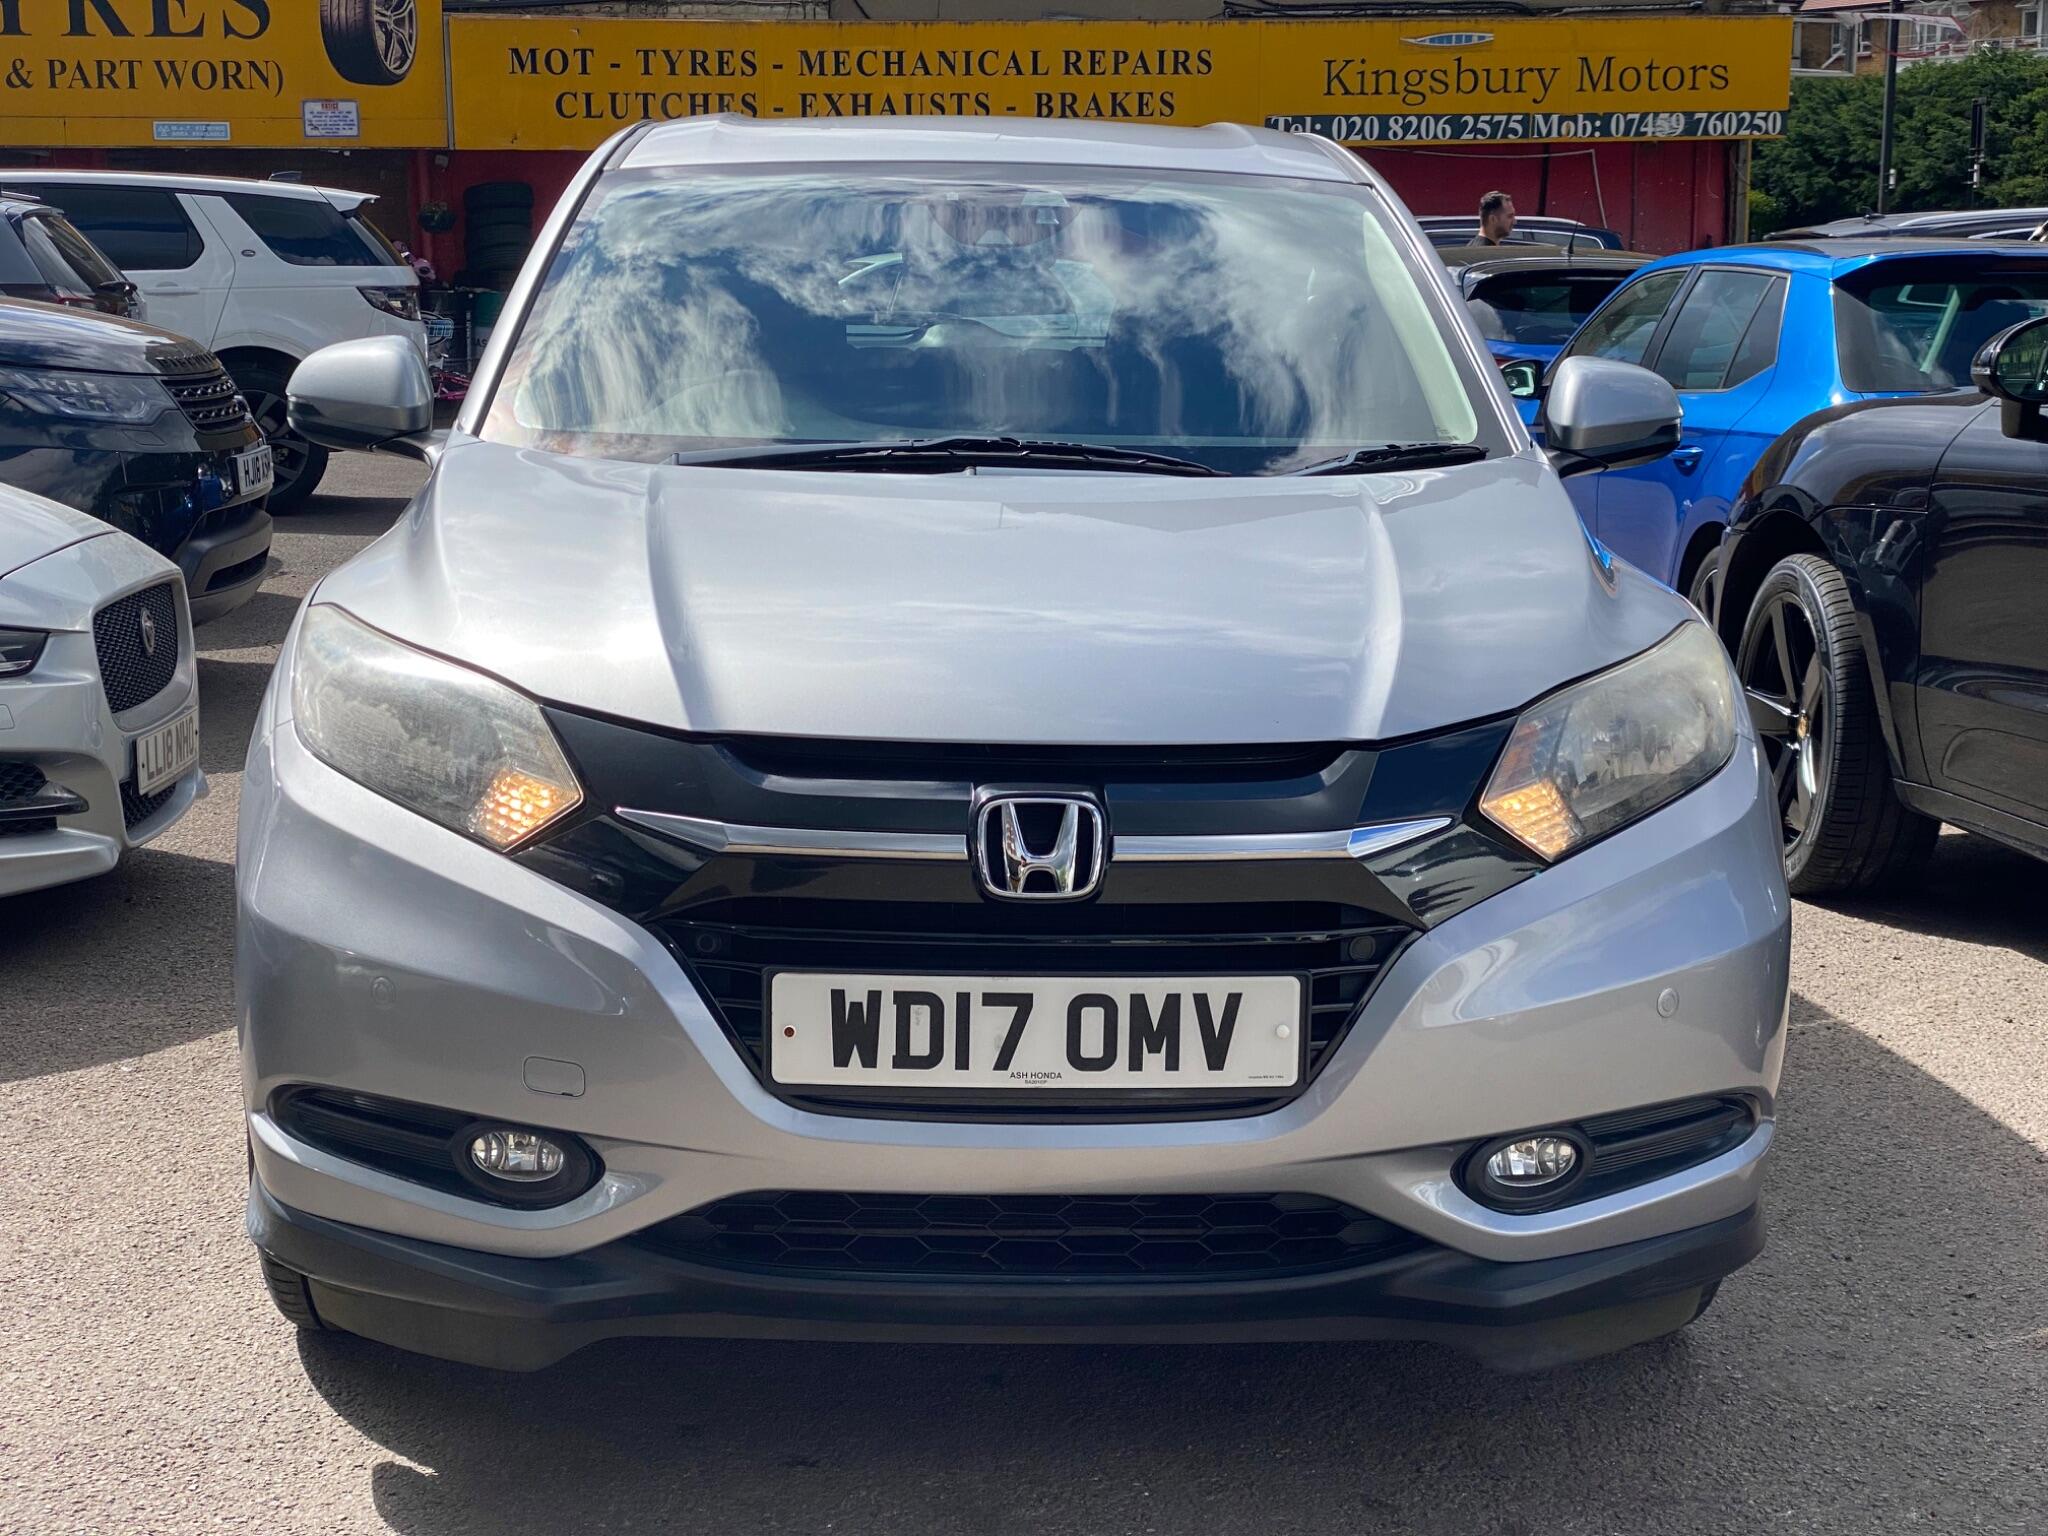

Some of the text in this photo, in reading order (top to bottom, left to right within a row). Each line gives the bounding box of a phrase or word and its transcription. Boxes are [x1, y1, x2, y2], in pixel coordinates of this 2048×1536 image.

[5, 58, 284, 97] & PART WORN)
[508, 48, 595, 75] MOT
[636, 50, 758, 77] TYRES
[797, 49, 1050, 77] MECHANICAL
[1062, 49, 1213, 76] REPAIRS
[1323, 56, 1730, 106] Kingsbury Motors
[555, 91, 758, 119] CLUTCHES
[799, 92, 991, 117] EXHAUSTS
[1034, 91, 1176, 118] BRAKES
[1331, 115, 1380, 141] 020
[1388, 114, 1451, 140] 8206
[1460, 113, 1524, 140] 2575
[1532, 114, 1601, 138] Mob:
[1693, 111, 1783, 136] 760250
[830, 988, 1243, 1072] WD17 OMV
[1030, 1072, 1062, 1080] HONDA
